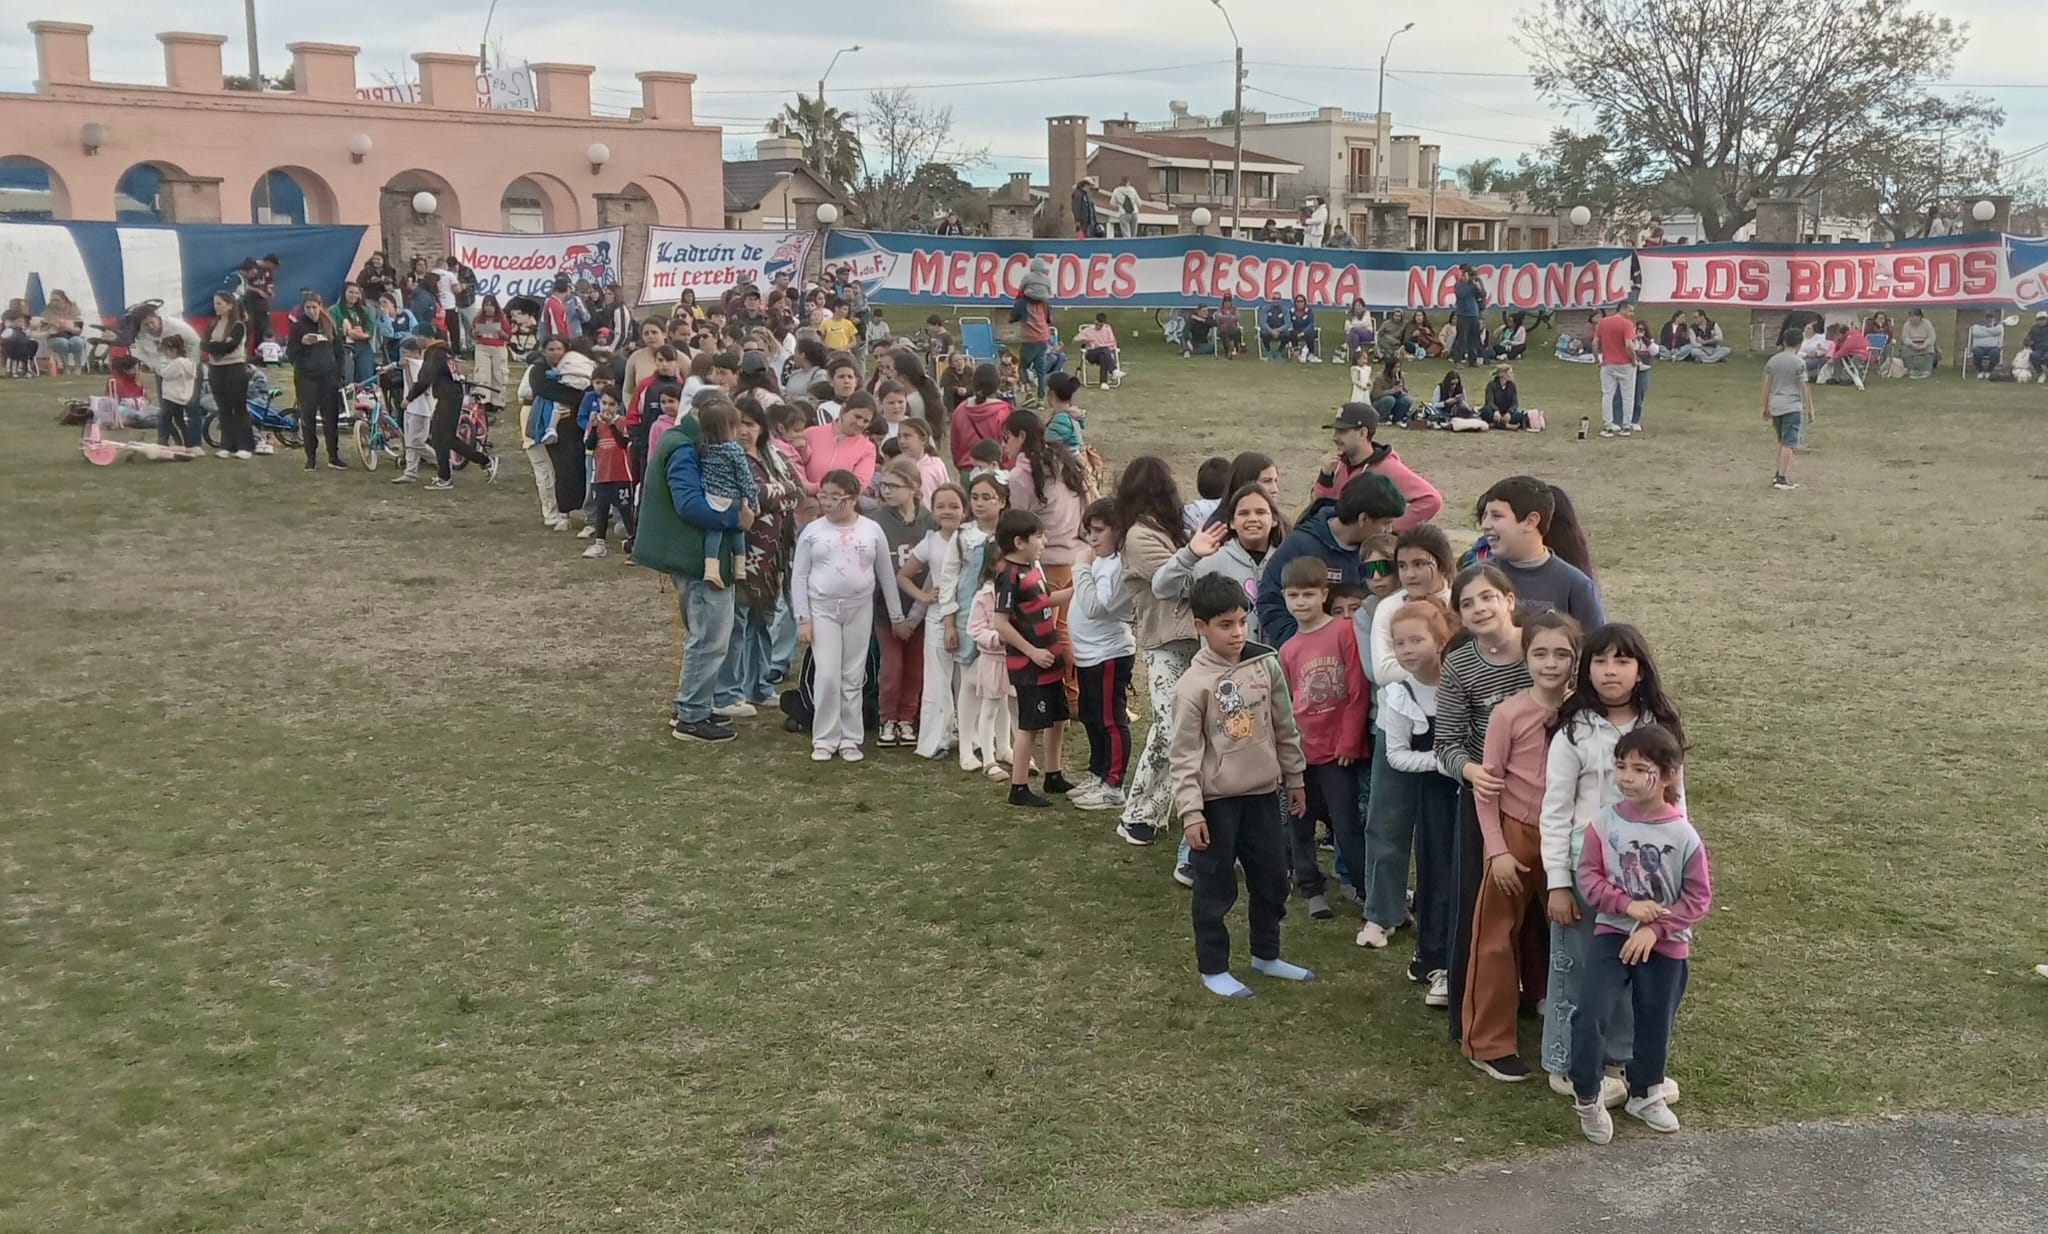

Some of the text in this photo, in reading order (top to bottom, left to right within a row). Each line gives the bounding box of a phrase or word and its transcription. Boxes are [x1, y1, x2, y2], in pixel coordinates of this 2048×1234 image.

[461, 246, 557, 271] Mercedes
[656, 241, 763, 264] Ladrón de
[653, 268, 676, 288] mi
[909, 250, 1136, 298] MERCDES
[1181, 251, 1362, 306] RESPIRA
[1671, 250, 1997, 302] LOS BOLSOS
